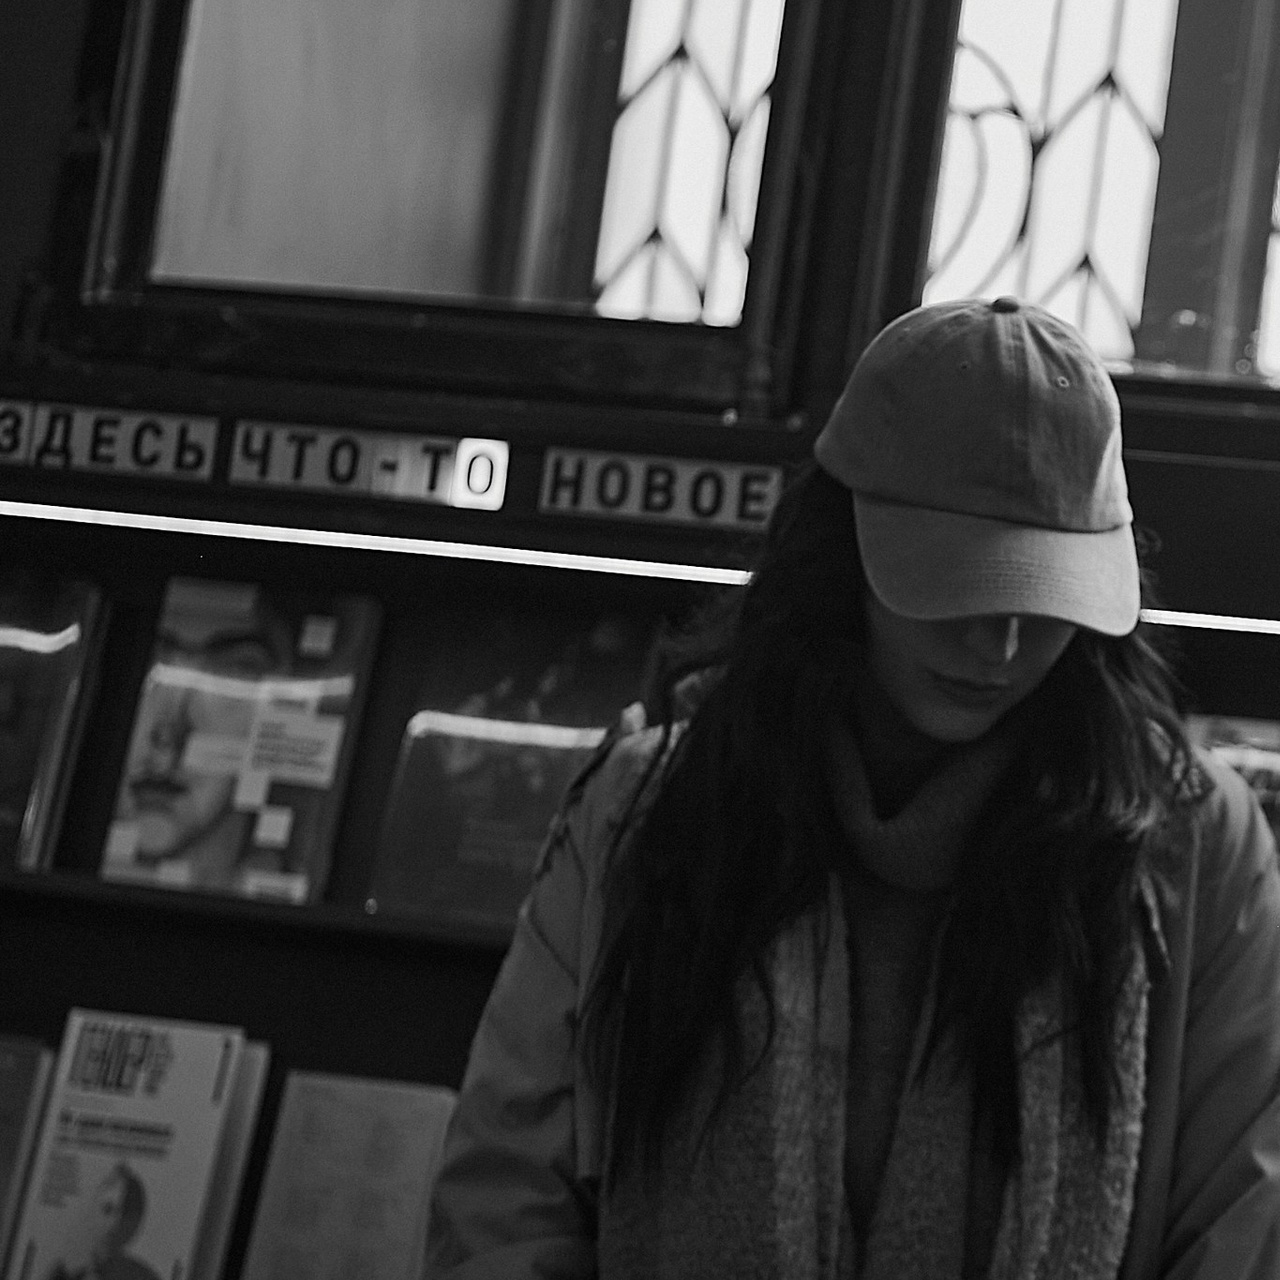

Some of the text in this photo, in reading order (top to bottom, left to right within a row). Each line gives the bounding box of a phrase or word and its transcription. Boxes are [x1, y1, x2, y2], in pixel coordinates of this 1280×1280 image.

[0, 409, 773, 518] ЗДЕСЬ ЧТО-ТО НОВОЕ
